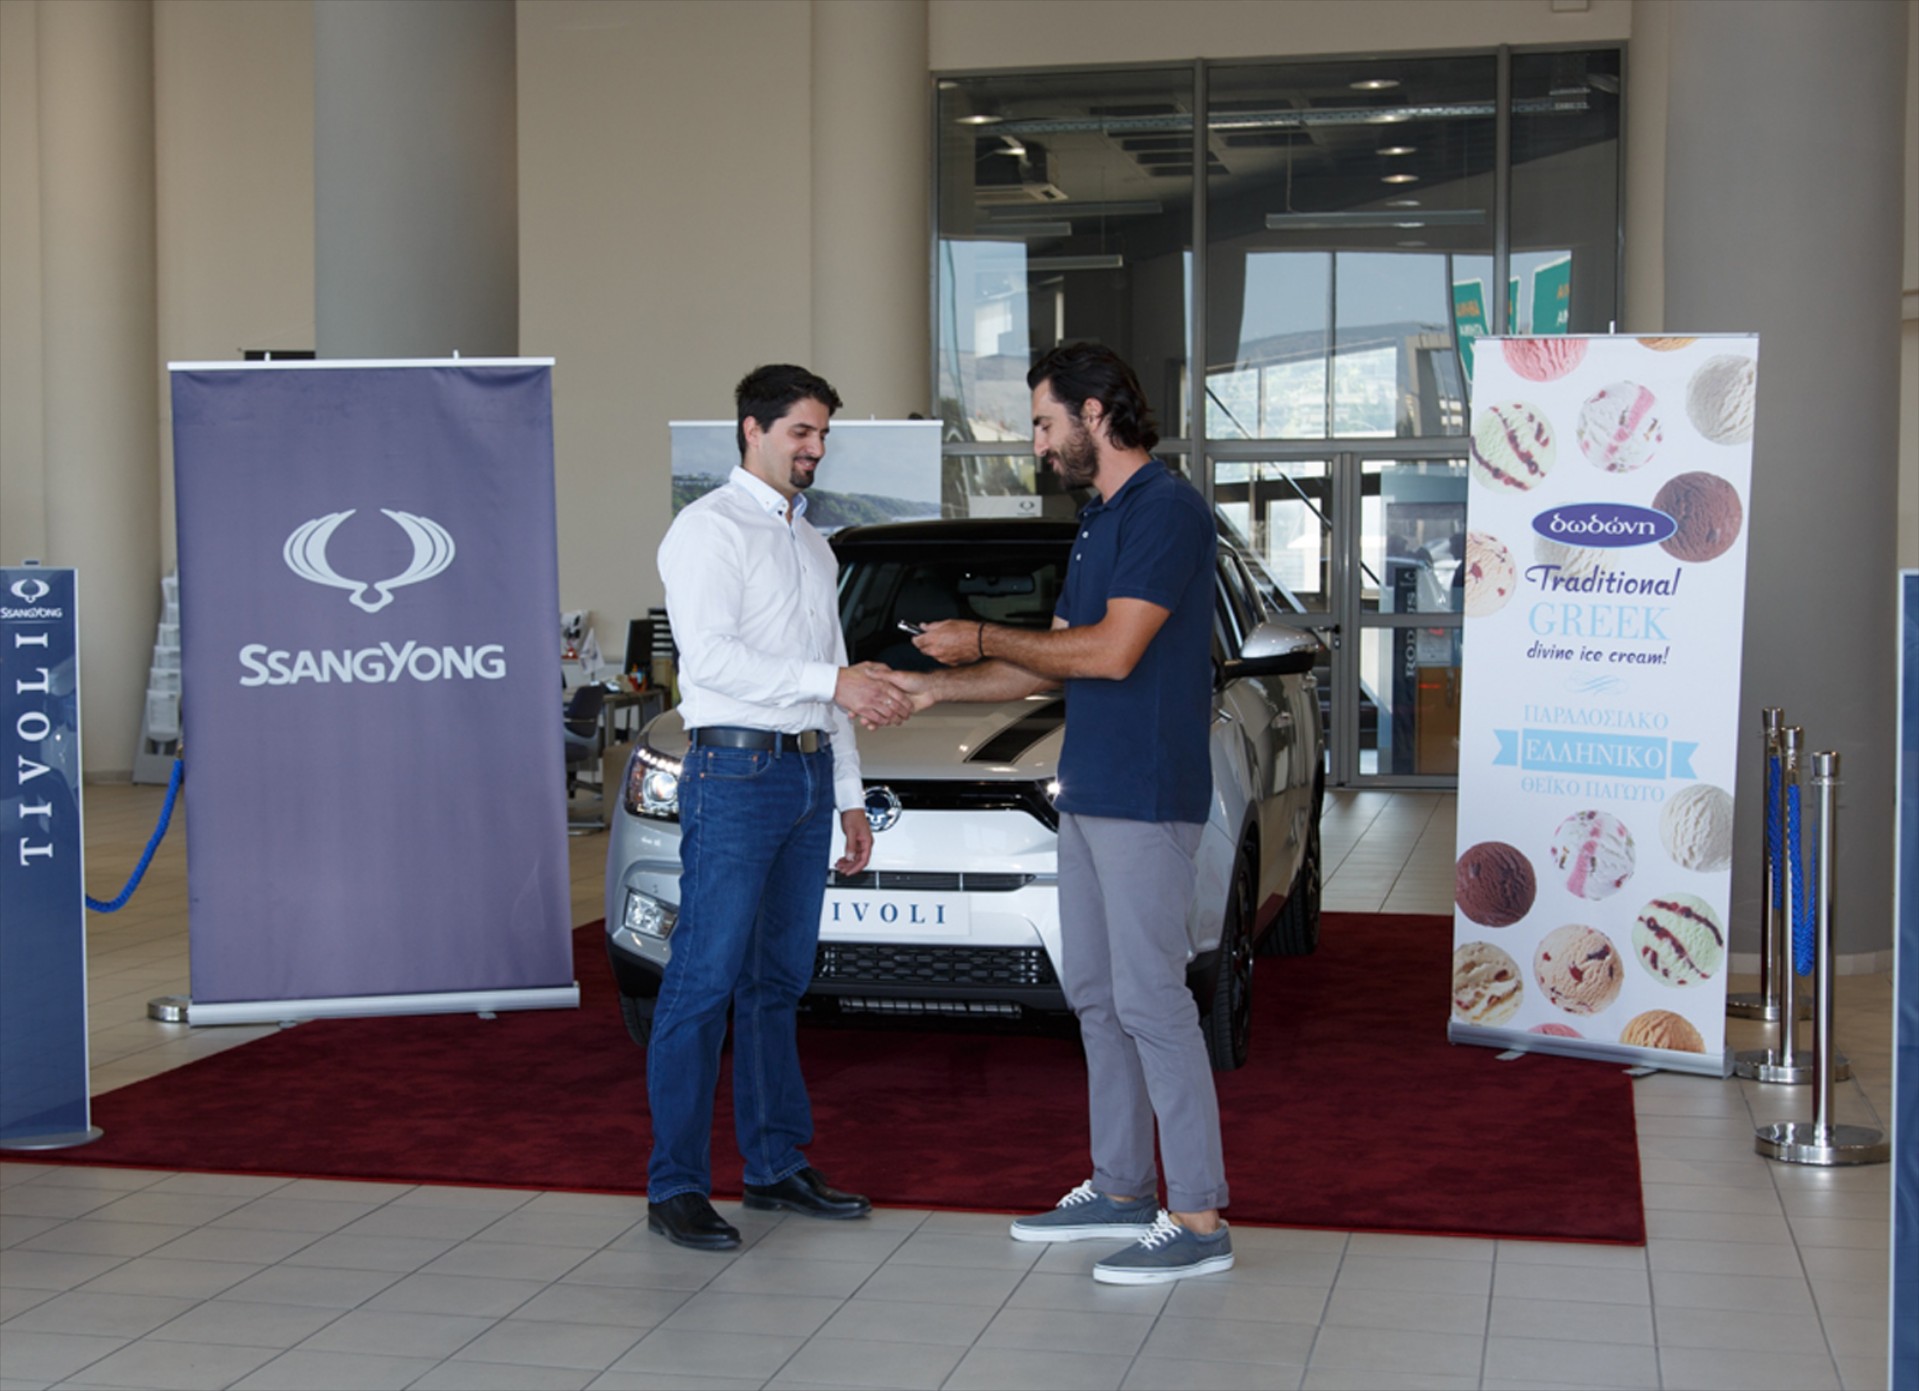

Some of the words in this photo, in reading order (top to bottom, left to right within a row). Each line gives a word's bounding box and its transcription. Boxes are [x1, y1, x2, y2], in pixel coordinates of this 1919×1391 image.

[1525, 564, 1682, 596] Traditional
[1405, 592, 1416, 677] RODS
[1528, 601, 1671, 640] GREEK
[239, 641, 507, 686] SSANGYONG
[1527, 640, 1574, 660] divine
[1580, 646, 1603, 662] ice
[1608, 646, 1671, 665] cream!
[15, 632, 53, 866] TIVOLI
[1525, 738, 1664, 769] ΕΛΛΗΝΙΚΟ
[1585, 781, 1665, 802] ΠΑΓΩΤΟ
[832, 902, 946, 924] IVOLI
